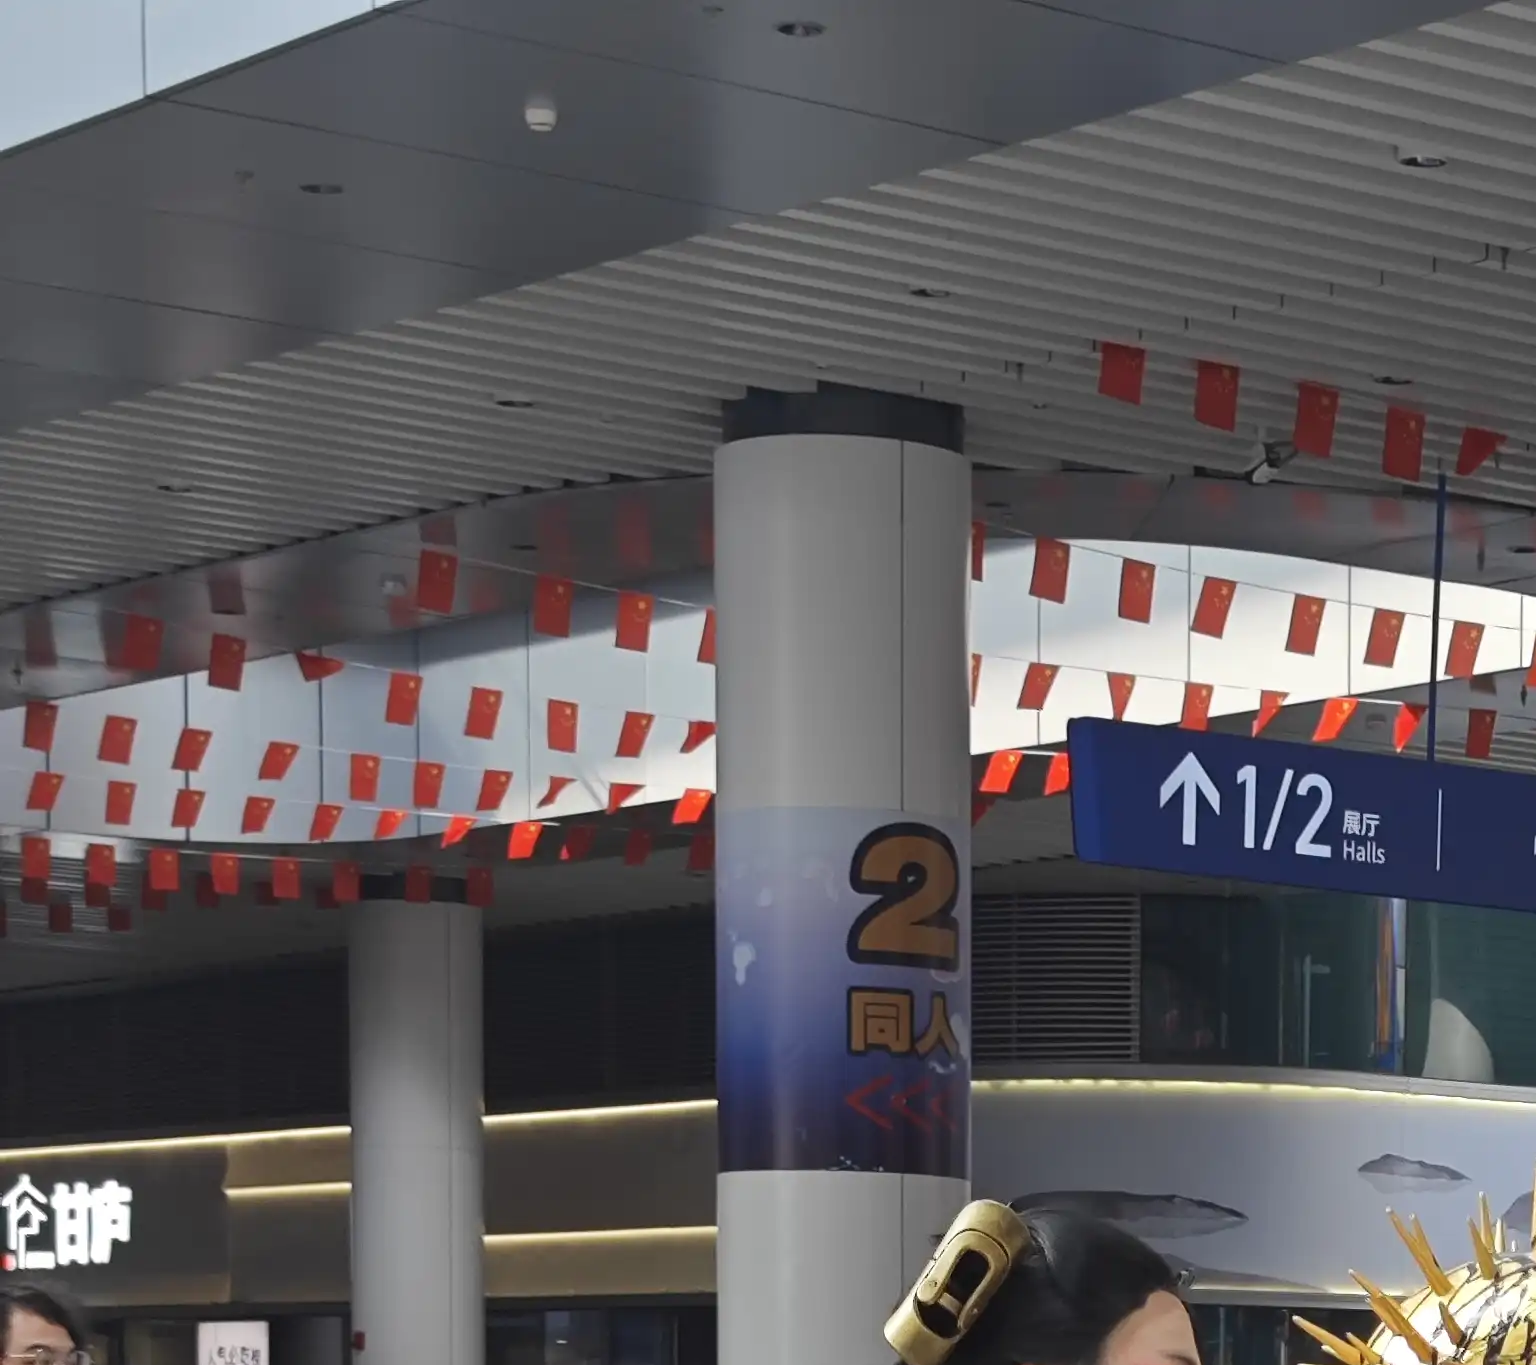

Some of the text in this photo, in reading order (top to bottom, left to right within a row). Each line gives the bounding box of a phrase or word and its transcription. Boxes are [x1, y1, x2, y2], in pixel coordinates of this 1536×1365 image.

[1236, 764, 1333, 858] 1/2
[1342, 809, 1381, 837] 展厅
[1342, 839, 1386, 864] Halls
[848, 823, 959, 972] 2
[847, 986, 958, 1057] 同人
